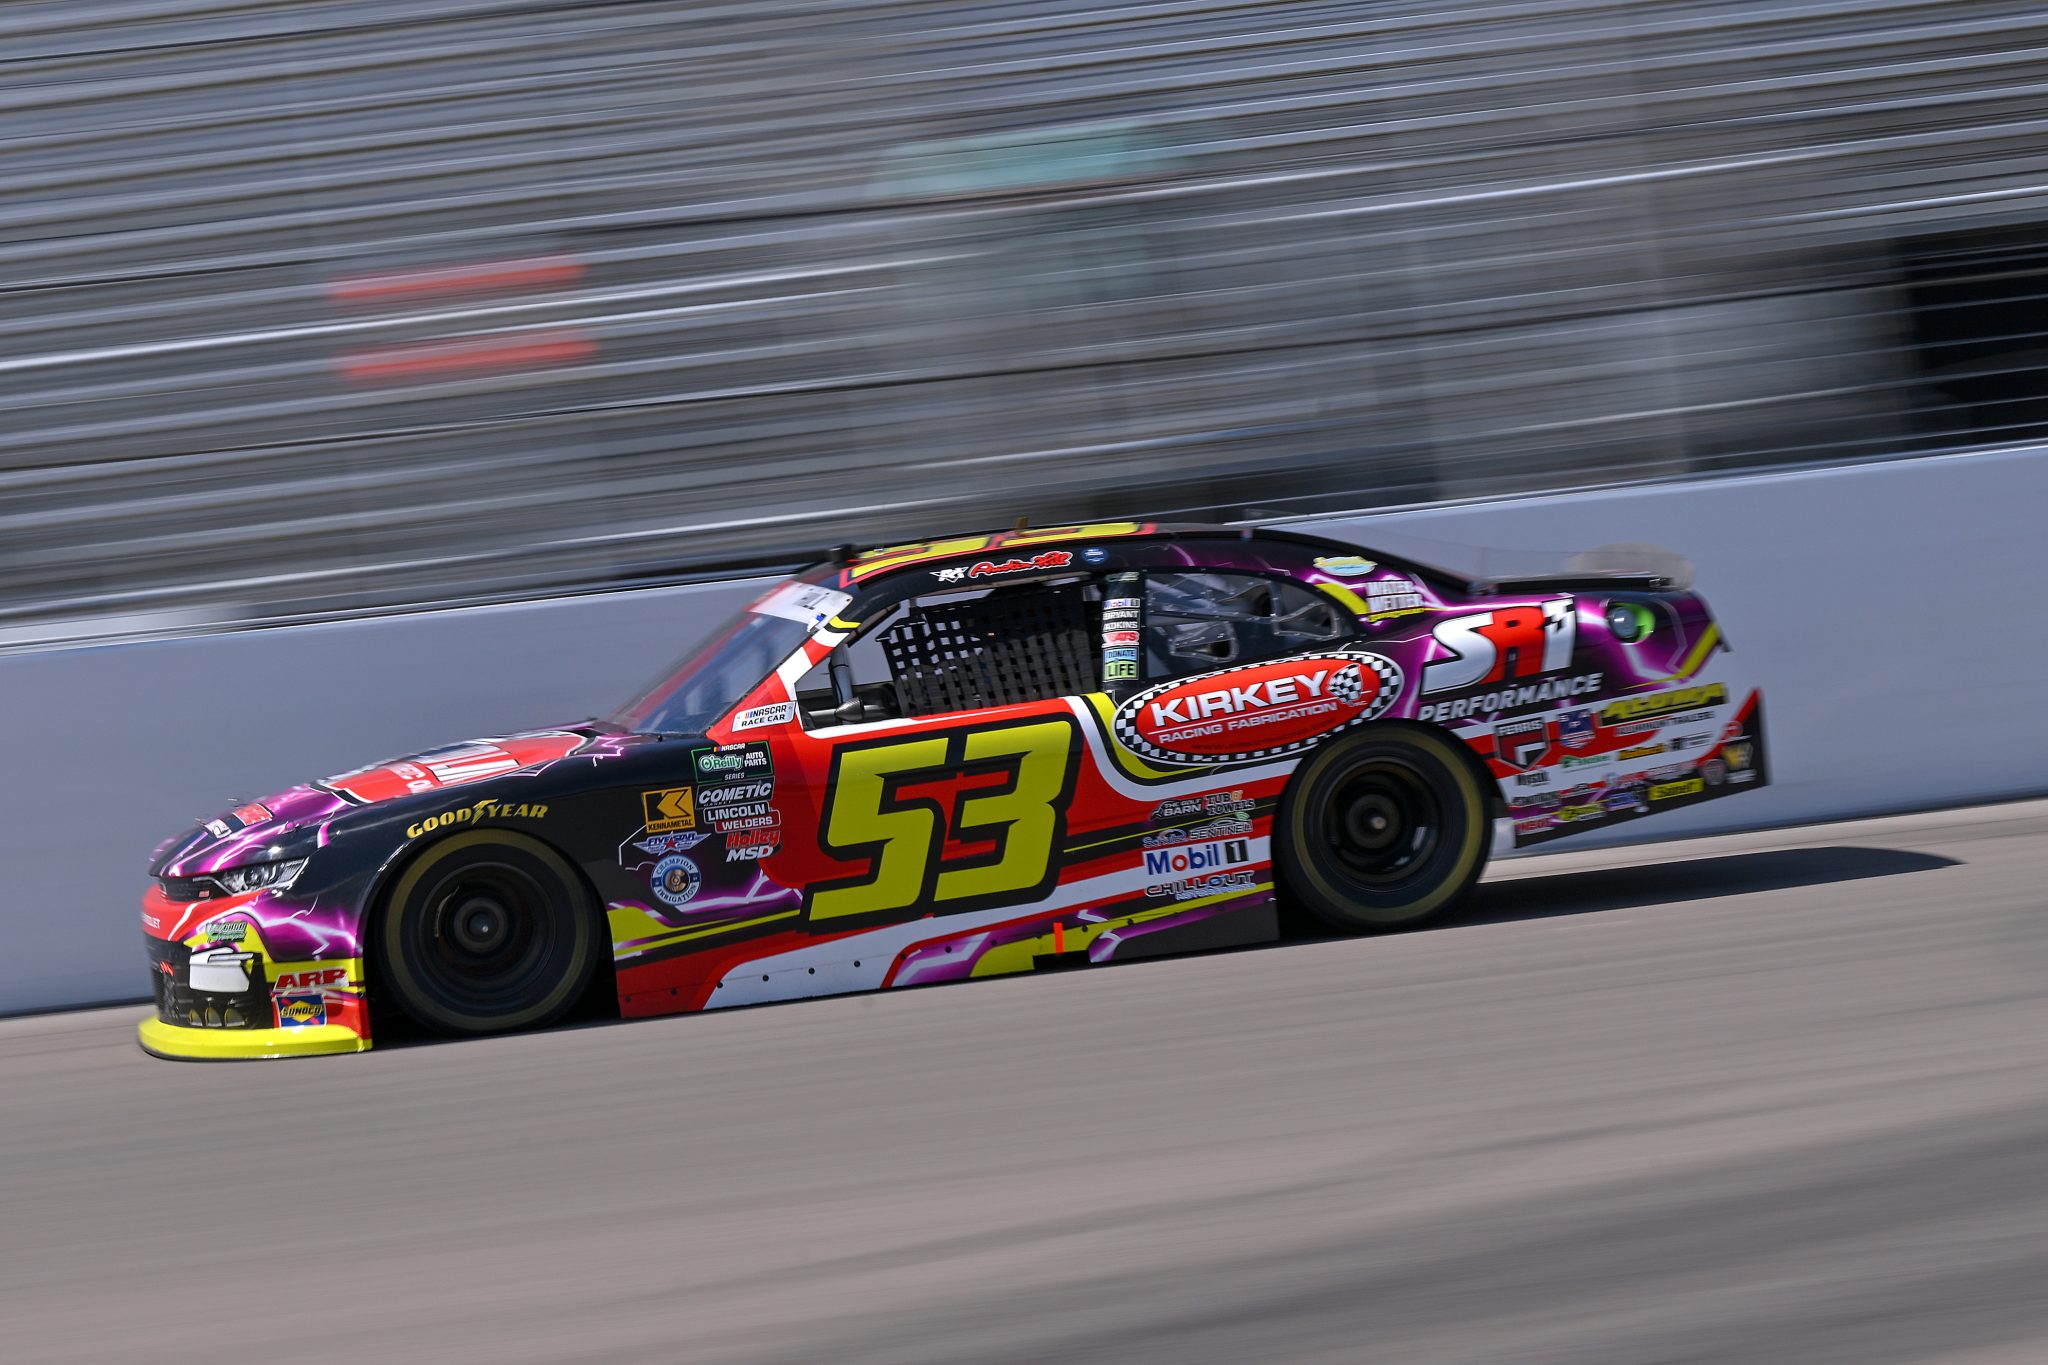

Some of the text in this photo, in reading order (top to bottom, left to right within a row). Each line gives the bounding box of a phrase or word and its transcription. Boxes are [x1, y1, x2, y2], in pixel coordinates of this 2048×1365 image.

[1107, 650, 1136, 658] DONATE
[1108, 663, 1135, 677] LIFE
[1150, 669, 1329, 727] KIRKEY
[1417, 673, 1604, 723] PERFORMANCE
[752, 705, 787, 718] NASCAR
[741, 714, 786, 727] RACE CAR
[1158, 724, 1224, 744] RACING
[1227, 701, 1338, 731] FABRICATION
[721, 743, 746, 751] NASCAR
[745, 751, 764, 760] AUTO
[699, 754, 743, 771] O'Reilly
[744, 757, 768, 768] PARTS
[724, 772, 745, 780] SERIES
[698, 782, 772, 804] COMETIC
[406, 798, 549, 839] GOODYEAR
[707, 803, 766, 822] LINCOLN
[1164, 804, 1202, 817] BARN
[648, 818, 693, 832] KENNAMETAL
[721, 815, 773, 831] WELDERS
[808, 720, 1072, 921] 53
[726, 829, 781, 849] Holley
[725, 844, 775, 863] MSD
[1146, 843, 1221, 876] Mobil
[656, 858, 694, 875] CHAMPION
[1145, 870, 1256, 897] CHILLOUT
[656, 884, 698, 904] IRRIGATION
[276, 968, 348, 988] ARP
[281, 1004, 323, 1018] SUNOCO
